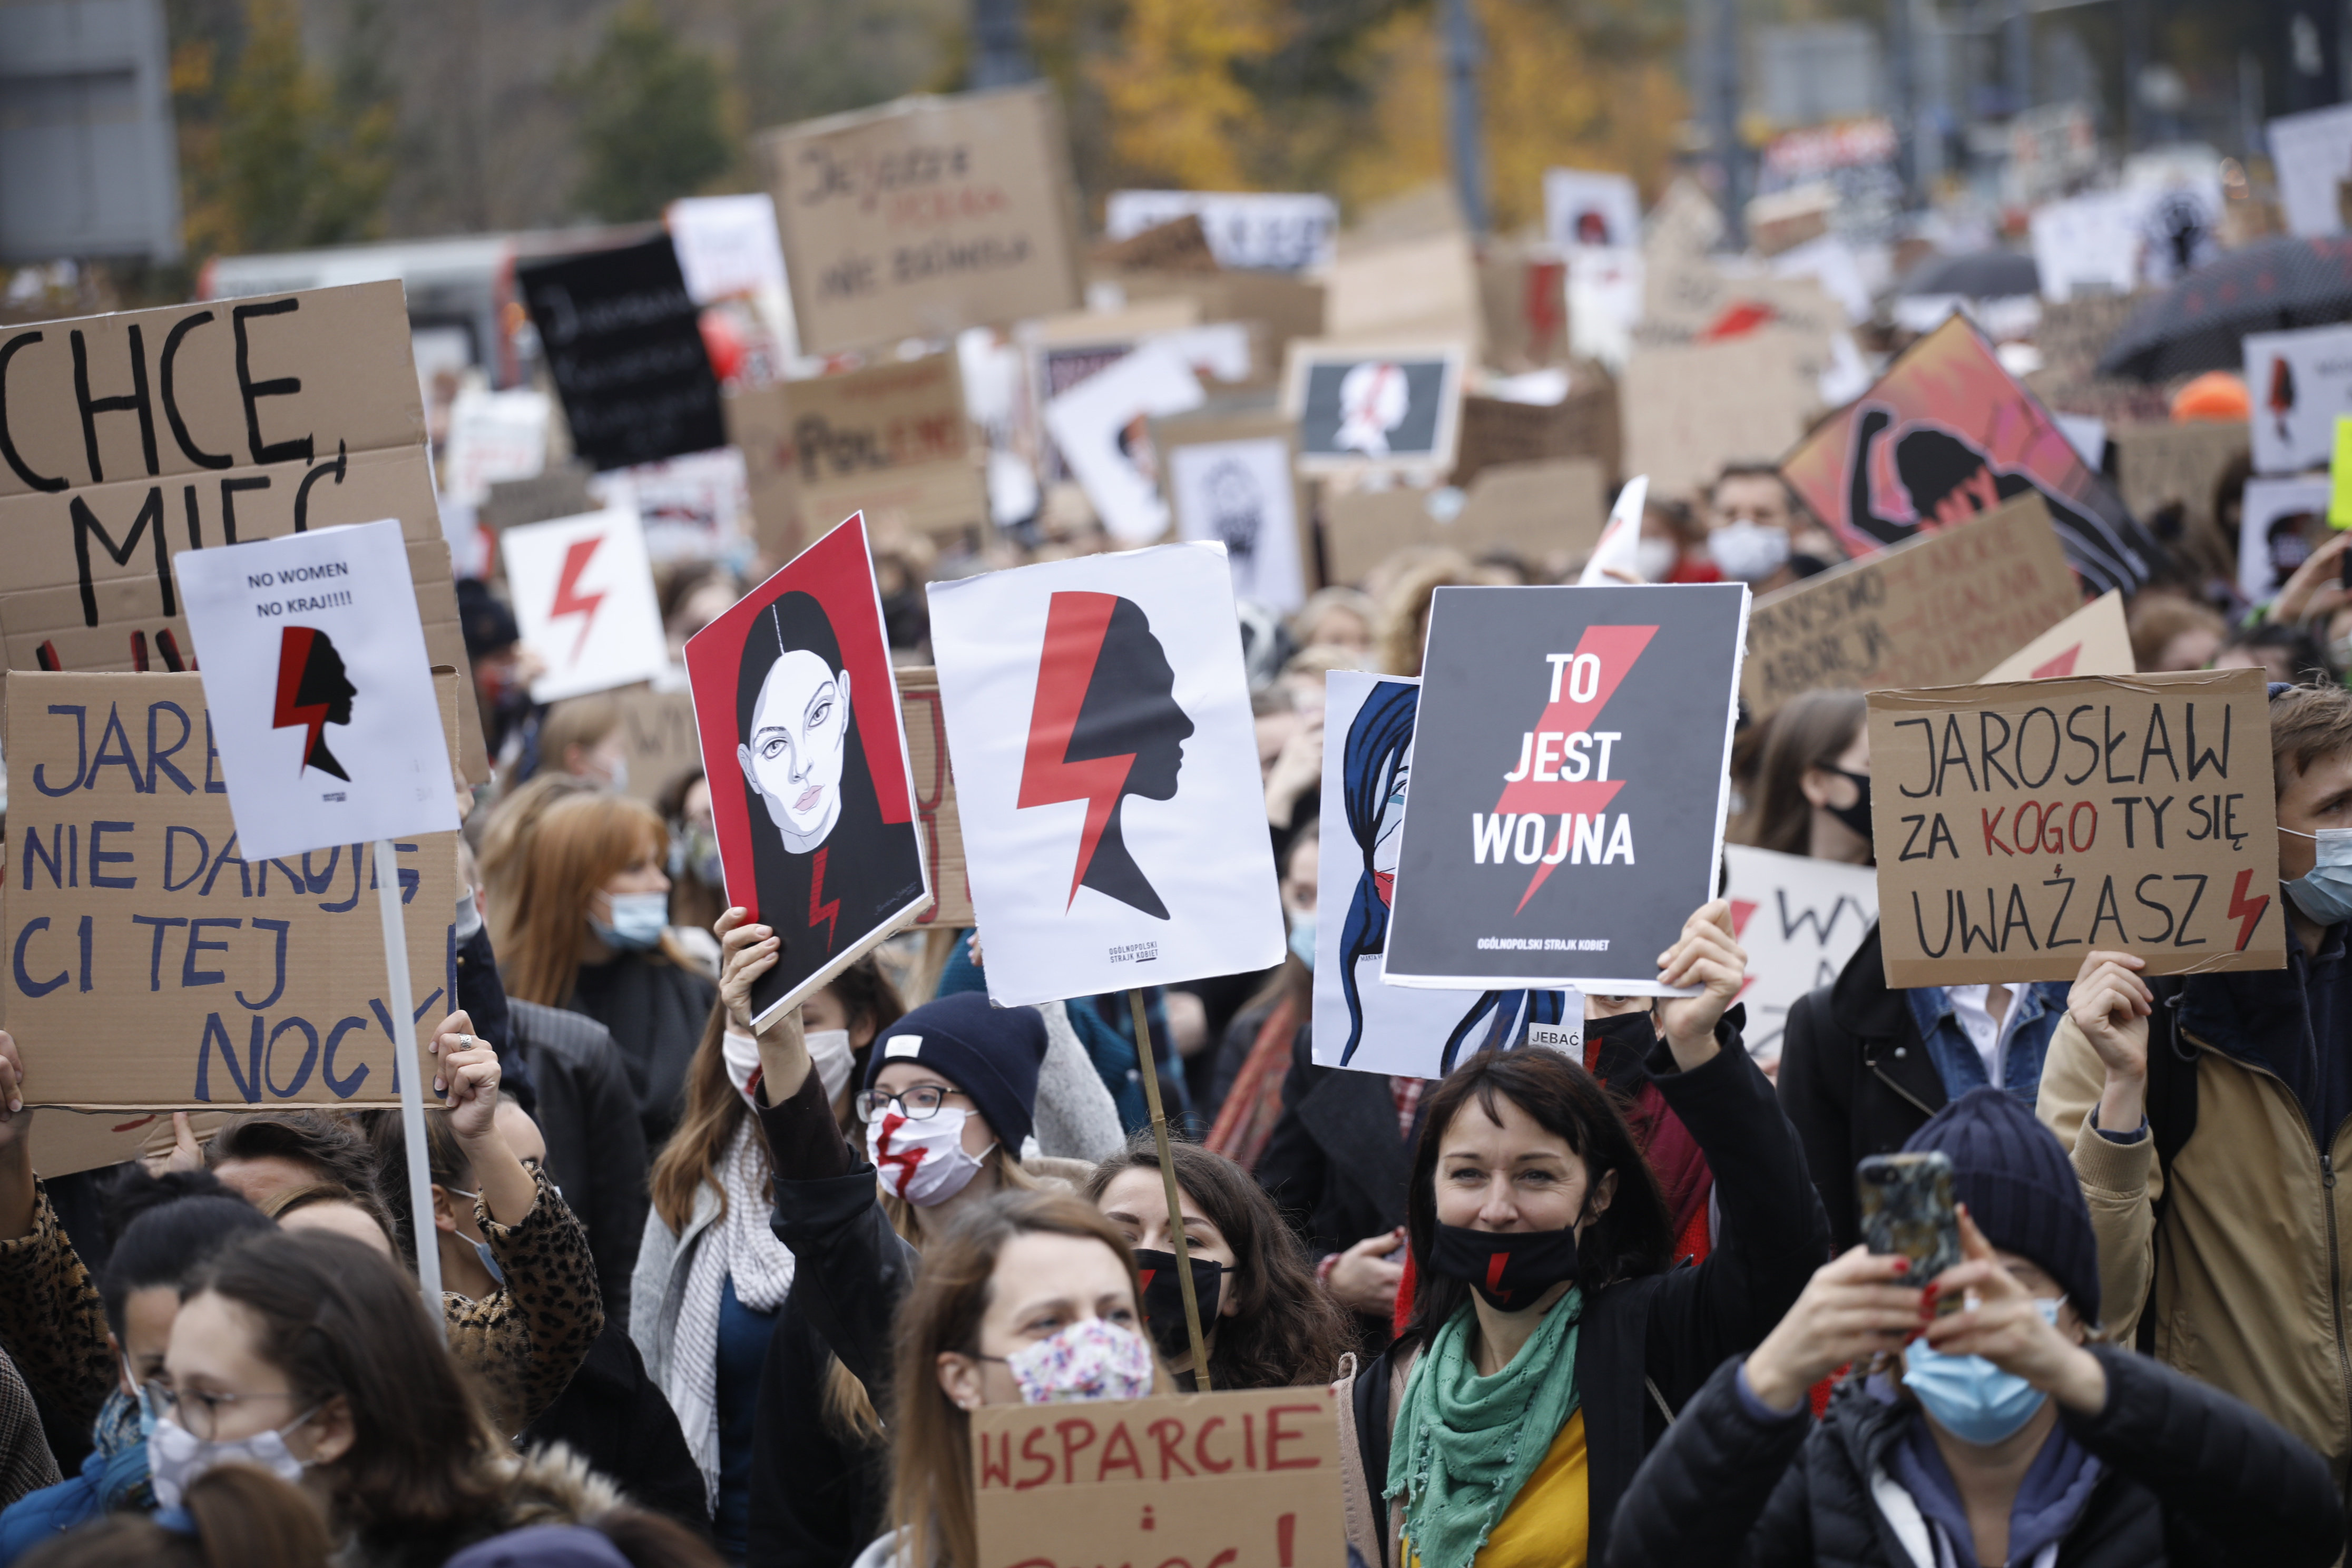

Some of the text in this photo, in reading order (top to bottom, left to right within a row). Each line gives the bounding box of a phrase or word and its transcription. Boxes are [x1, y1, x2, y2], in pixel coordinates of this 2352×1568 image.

[248, 562, 348, 588] NO WOMEN
[257, 590, 352, 618] NO KRAJ!!!!
[1545, 652, 1601, 703] TO
[1503, 731, 1622, 782] JEST
[1894, 702, 2231, 798] JAROSŁAW
[1472, 811, 1635, 866] WOJNA
[1898, 792, 2249, 862] ZA KOGO TY SIĘ
[23, 821, 138, 890] NIE
[1911, 863, 2209, 958] UWAŻASZ
[13, 914, 290, 1011] CI TEJ
[1109, 941, 1158, 955] OGÓLNOPOLSKI
[1110, 949, 1159, 964] STRAJK KOBIET
[1477, 936, 1610, 951] OGÓLNOPOLSKI STRAJK KOBIET
[1532, 1031, 1580, 1046] JEBAĆ
[979, 1404, 1324, 1491] WSPARCIE
